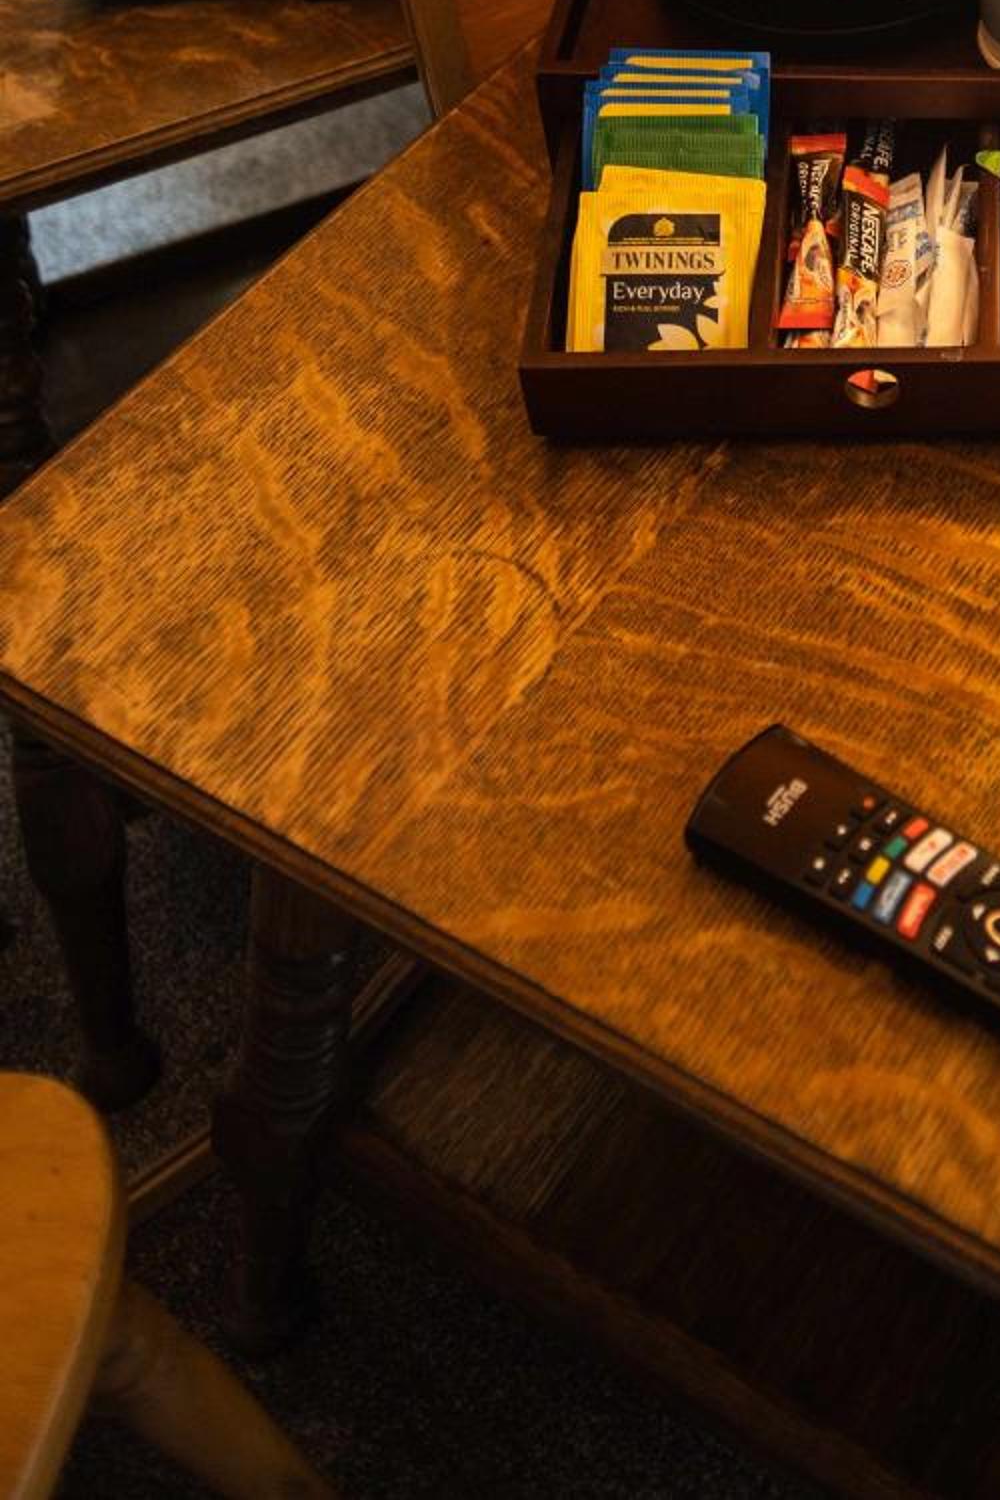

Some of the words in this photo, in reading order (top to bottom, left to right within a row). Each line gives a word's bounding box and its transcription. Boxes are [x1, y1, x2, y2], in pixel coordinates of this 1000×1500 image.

[611, 251, 715, 270] TWININGS
[613, 281, 704, 303] Everyday
[762, 778, 808, 827] BUSH
